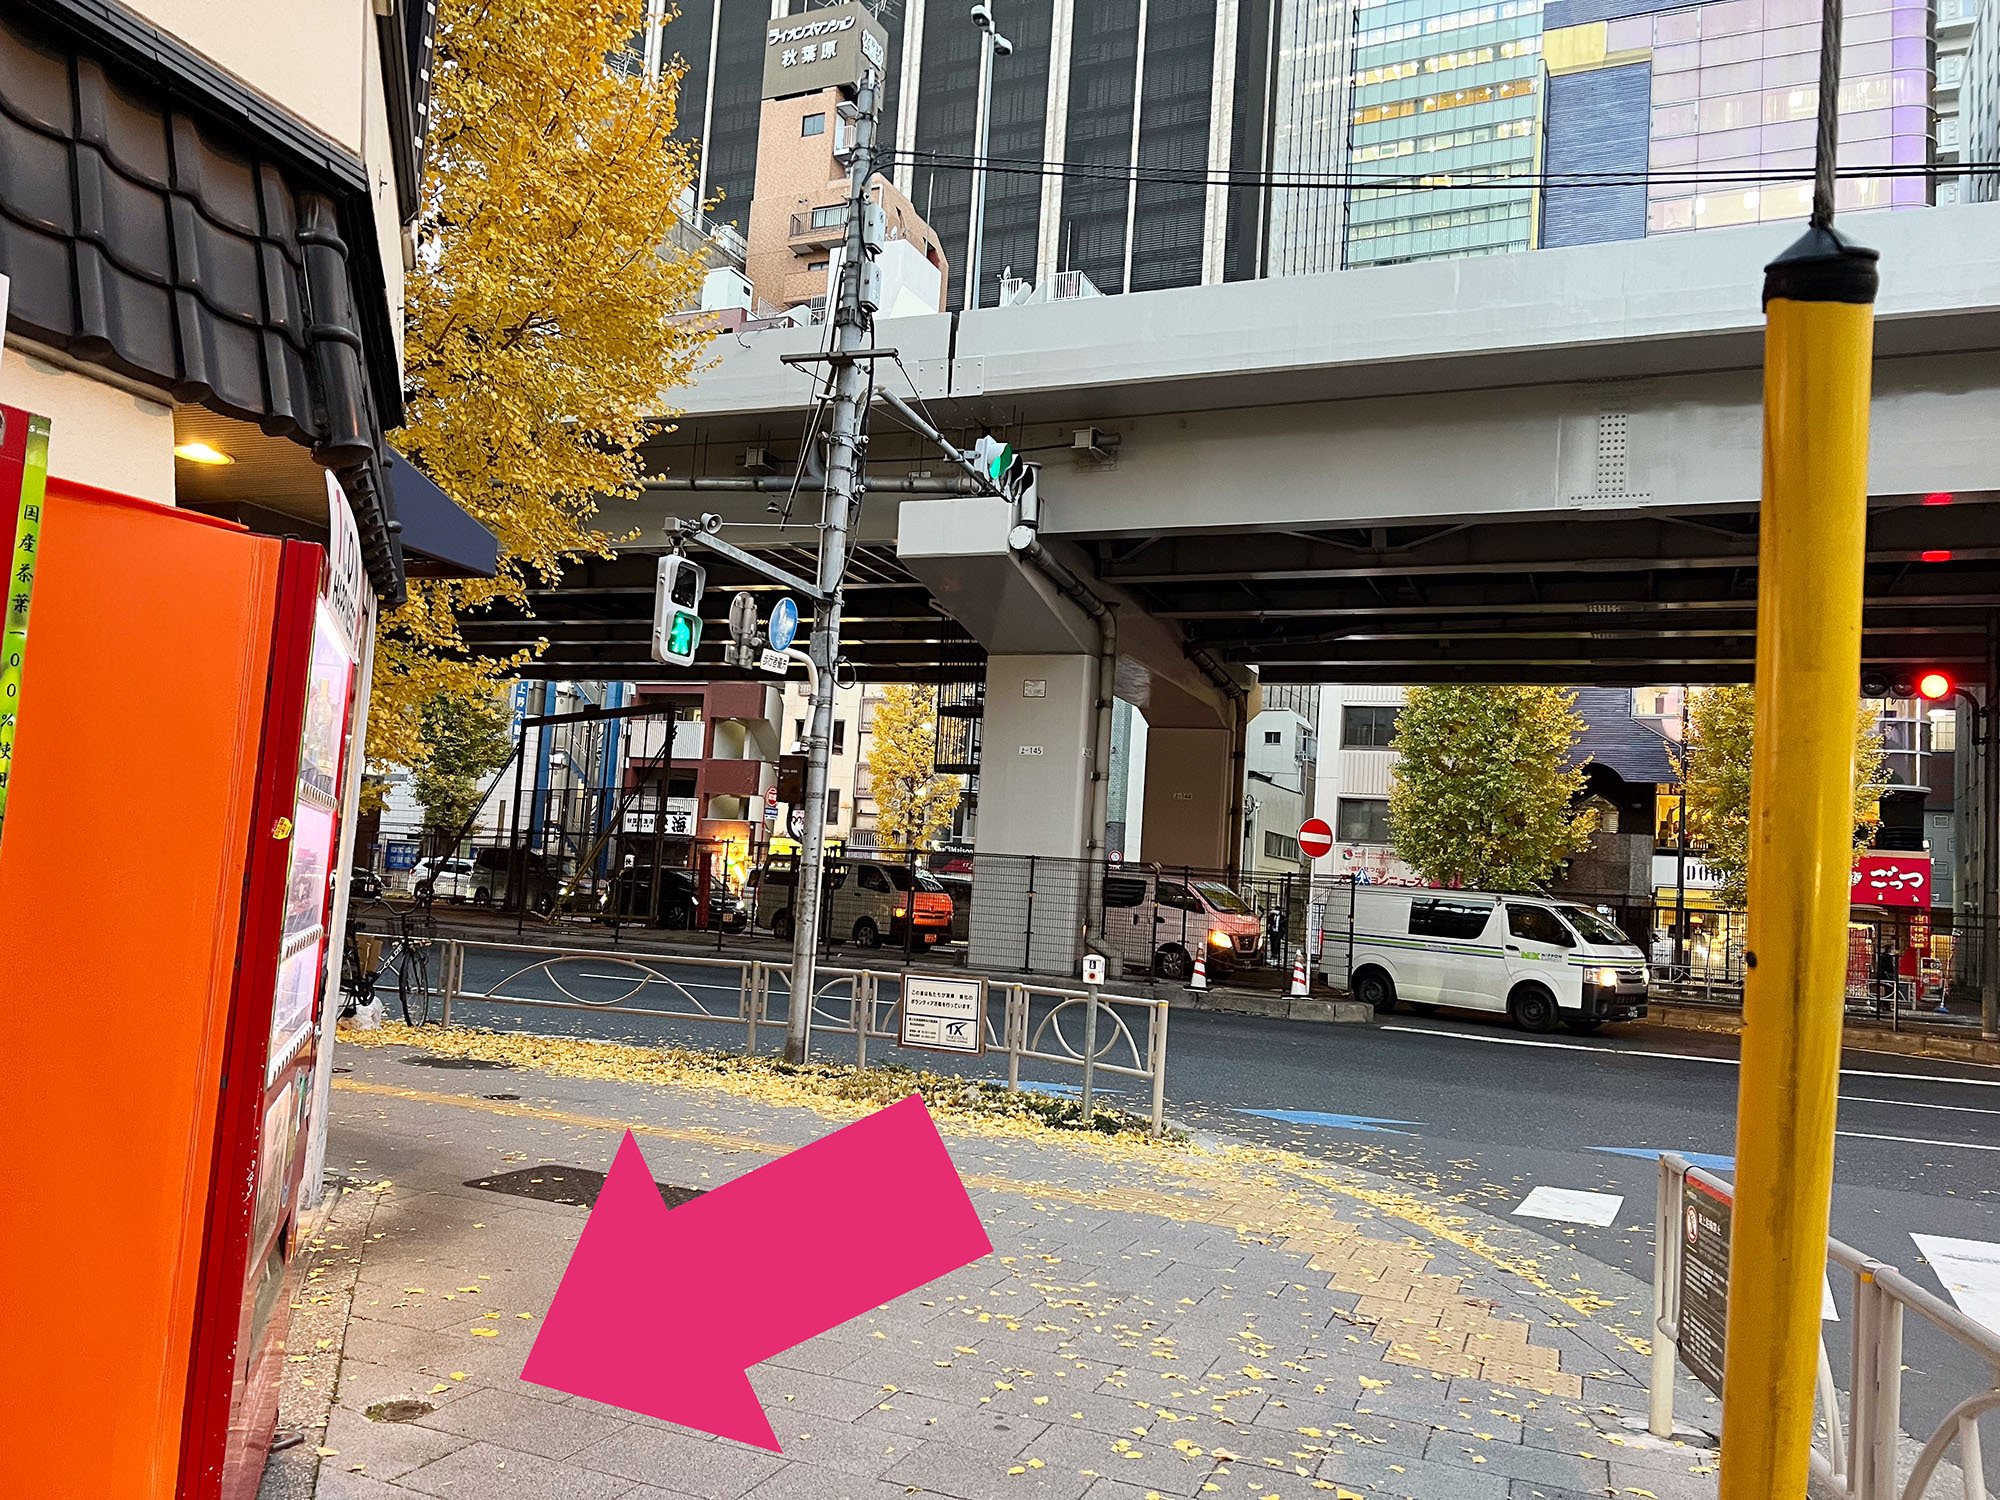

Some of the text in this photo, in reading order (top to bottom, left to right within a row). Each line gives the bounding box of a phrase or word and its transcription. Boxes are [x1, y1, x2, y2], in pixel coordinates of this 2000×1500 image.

[768, 16, 855, 46] ライオンズマンション
[781, 40, 838, 68] 秋葉原
[1870, 865, 1924, 890] ごっつ
[945, 1021, 968, 1036] TX
